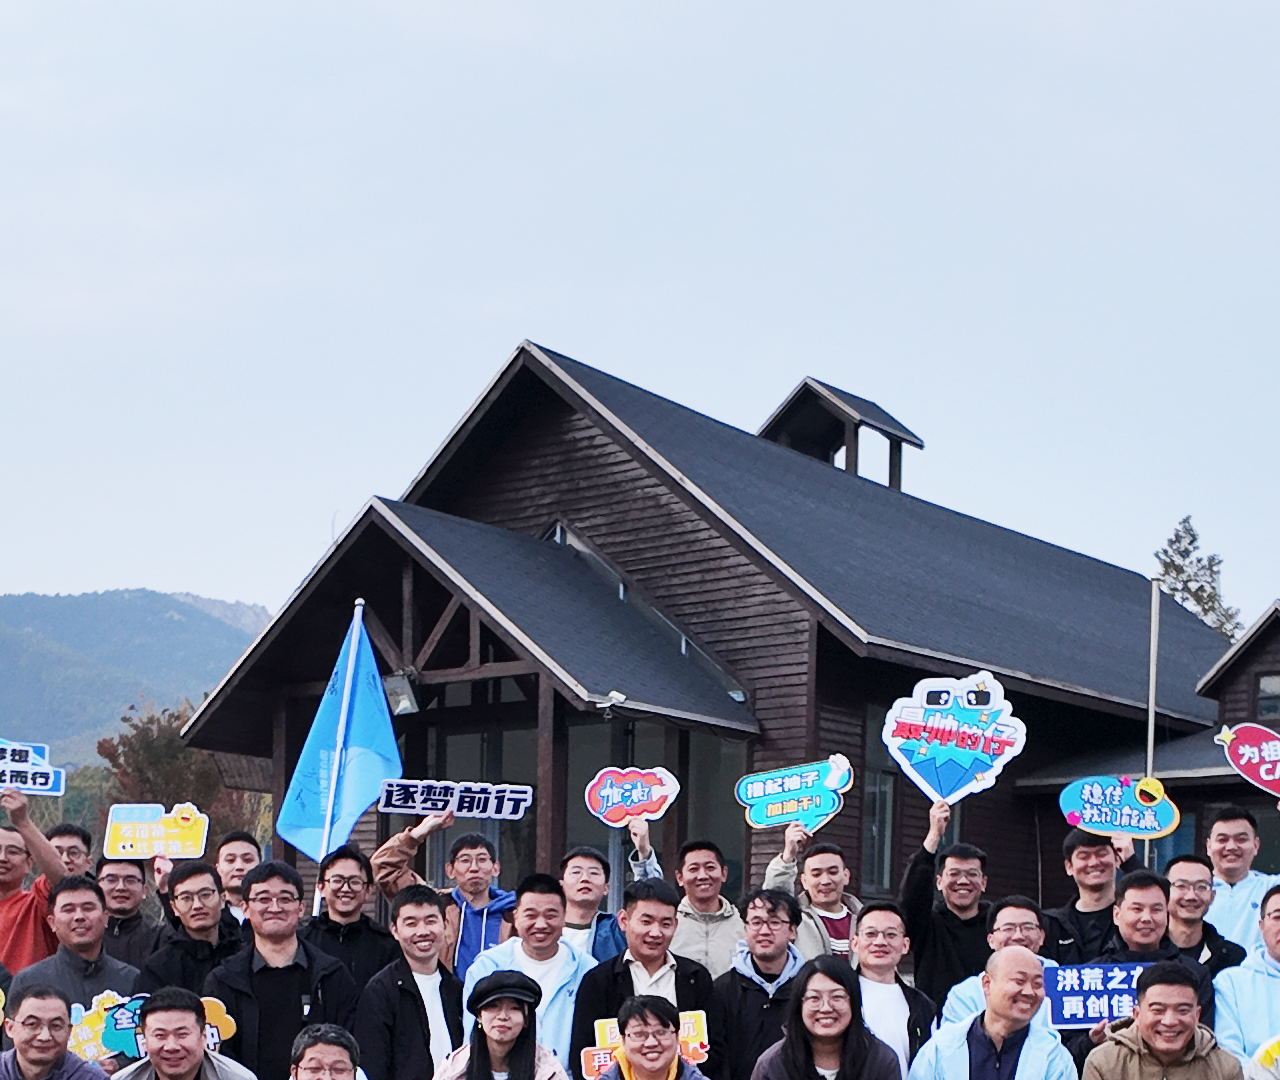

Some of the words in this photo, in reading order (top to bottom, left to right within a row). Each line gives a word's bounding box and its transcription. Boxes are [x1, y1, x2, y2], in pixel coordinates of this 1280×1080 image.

[891, 706, 1018, 756] 最帅的仔
[383, 783, 529, 816] 逐梦前行
[599, 777, 651, 814] 加油
[1081, 782, 1123, 805] 稳住
[1081, 803, 1161, 831] 我们能赢
[1062, 993, 1138, 1018] 再创佳
